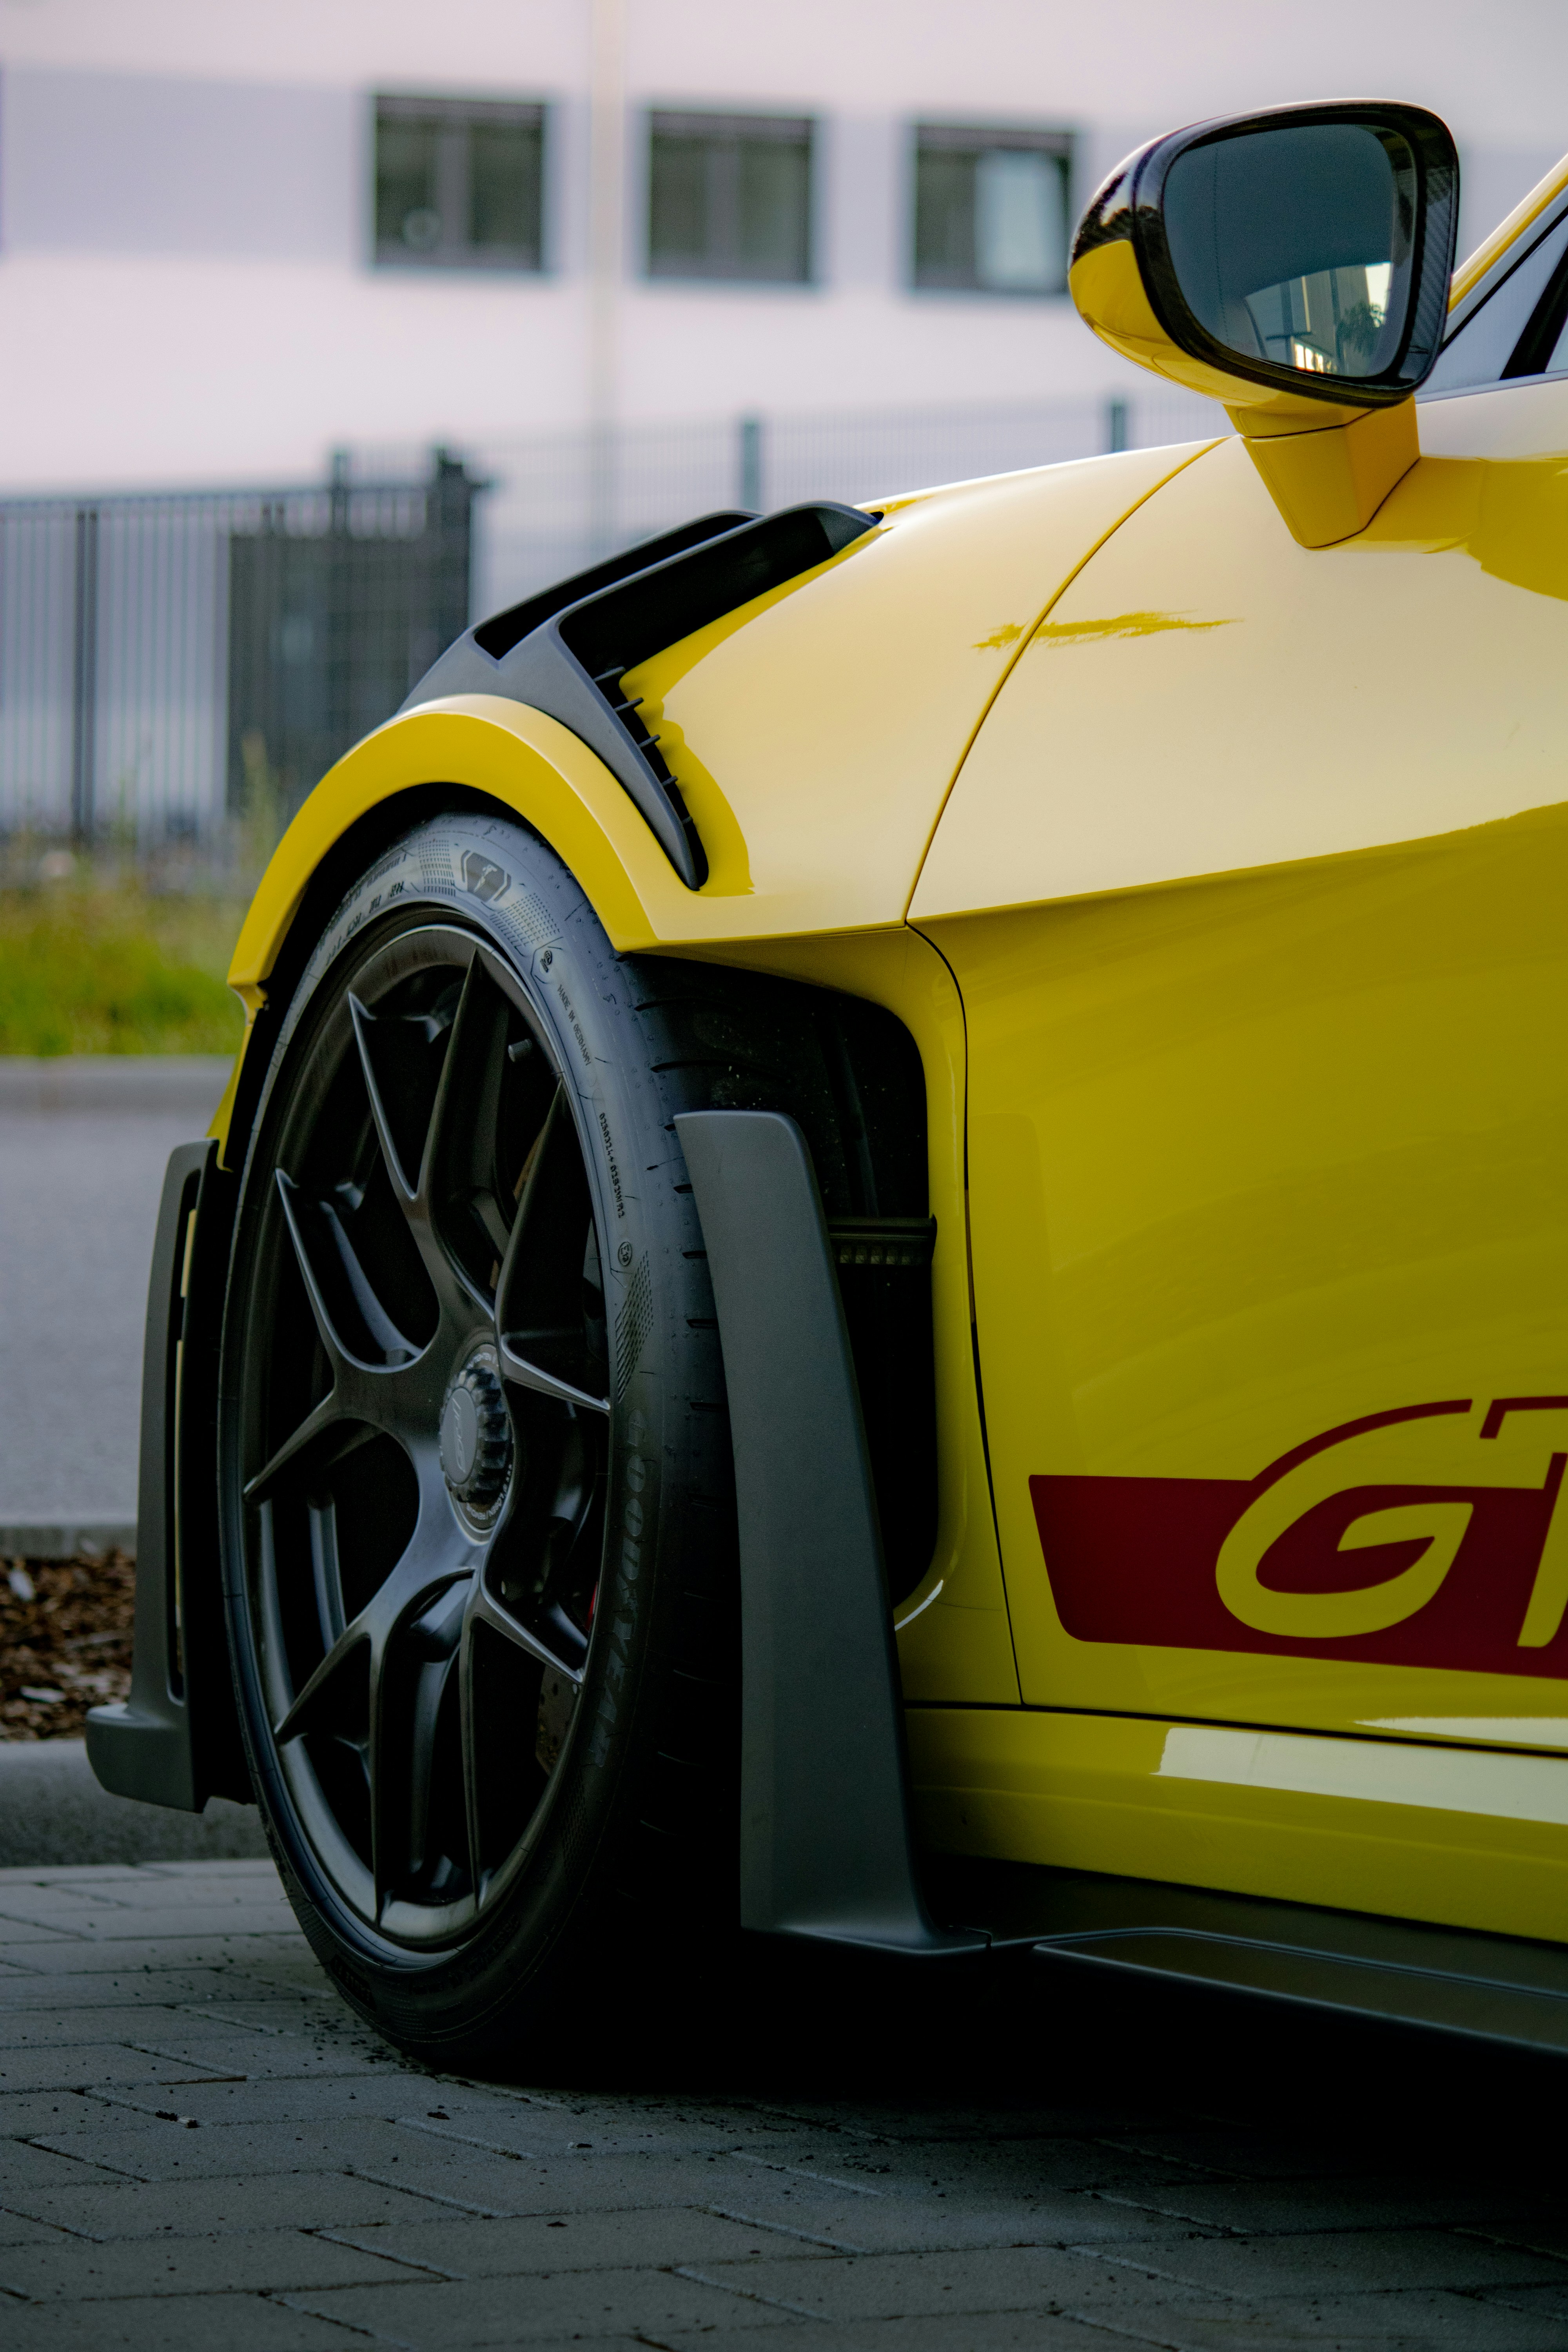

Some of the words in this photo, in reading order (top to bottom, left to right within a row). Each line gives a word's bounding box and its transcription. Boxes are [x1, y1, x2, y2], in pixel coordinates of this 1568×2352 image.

[557, 984, 570, 1010] MADE
[568, 1010, 575, 1023] IN
[573, 1024, 591, 1066] GERMANY
